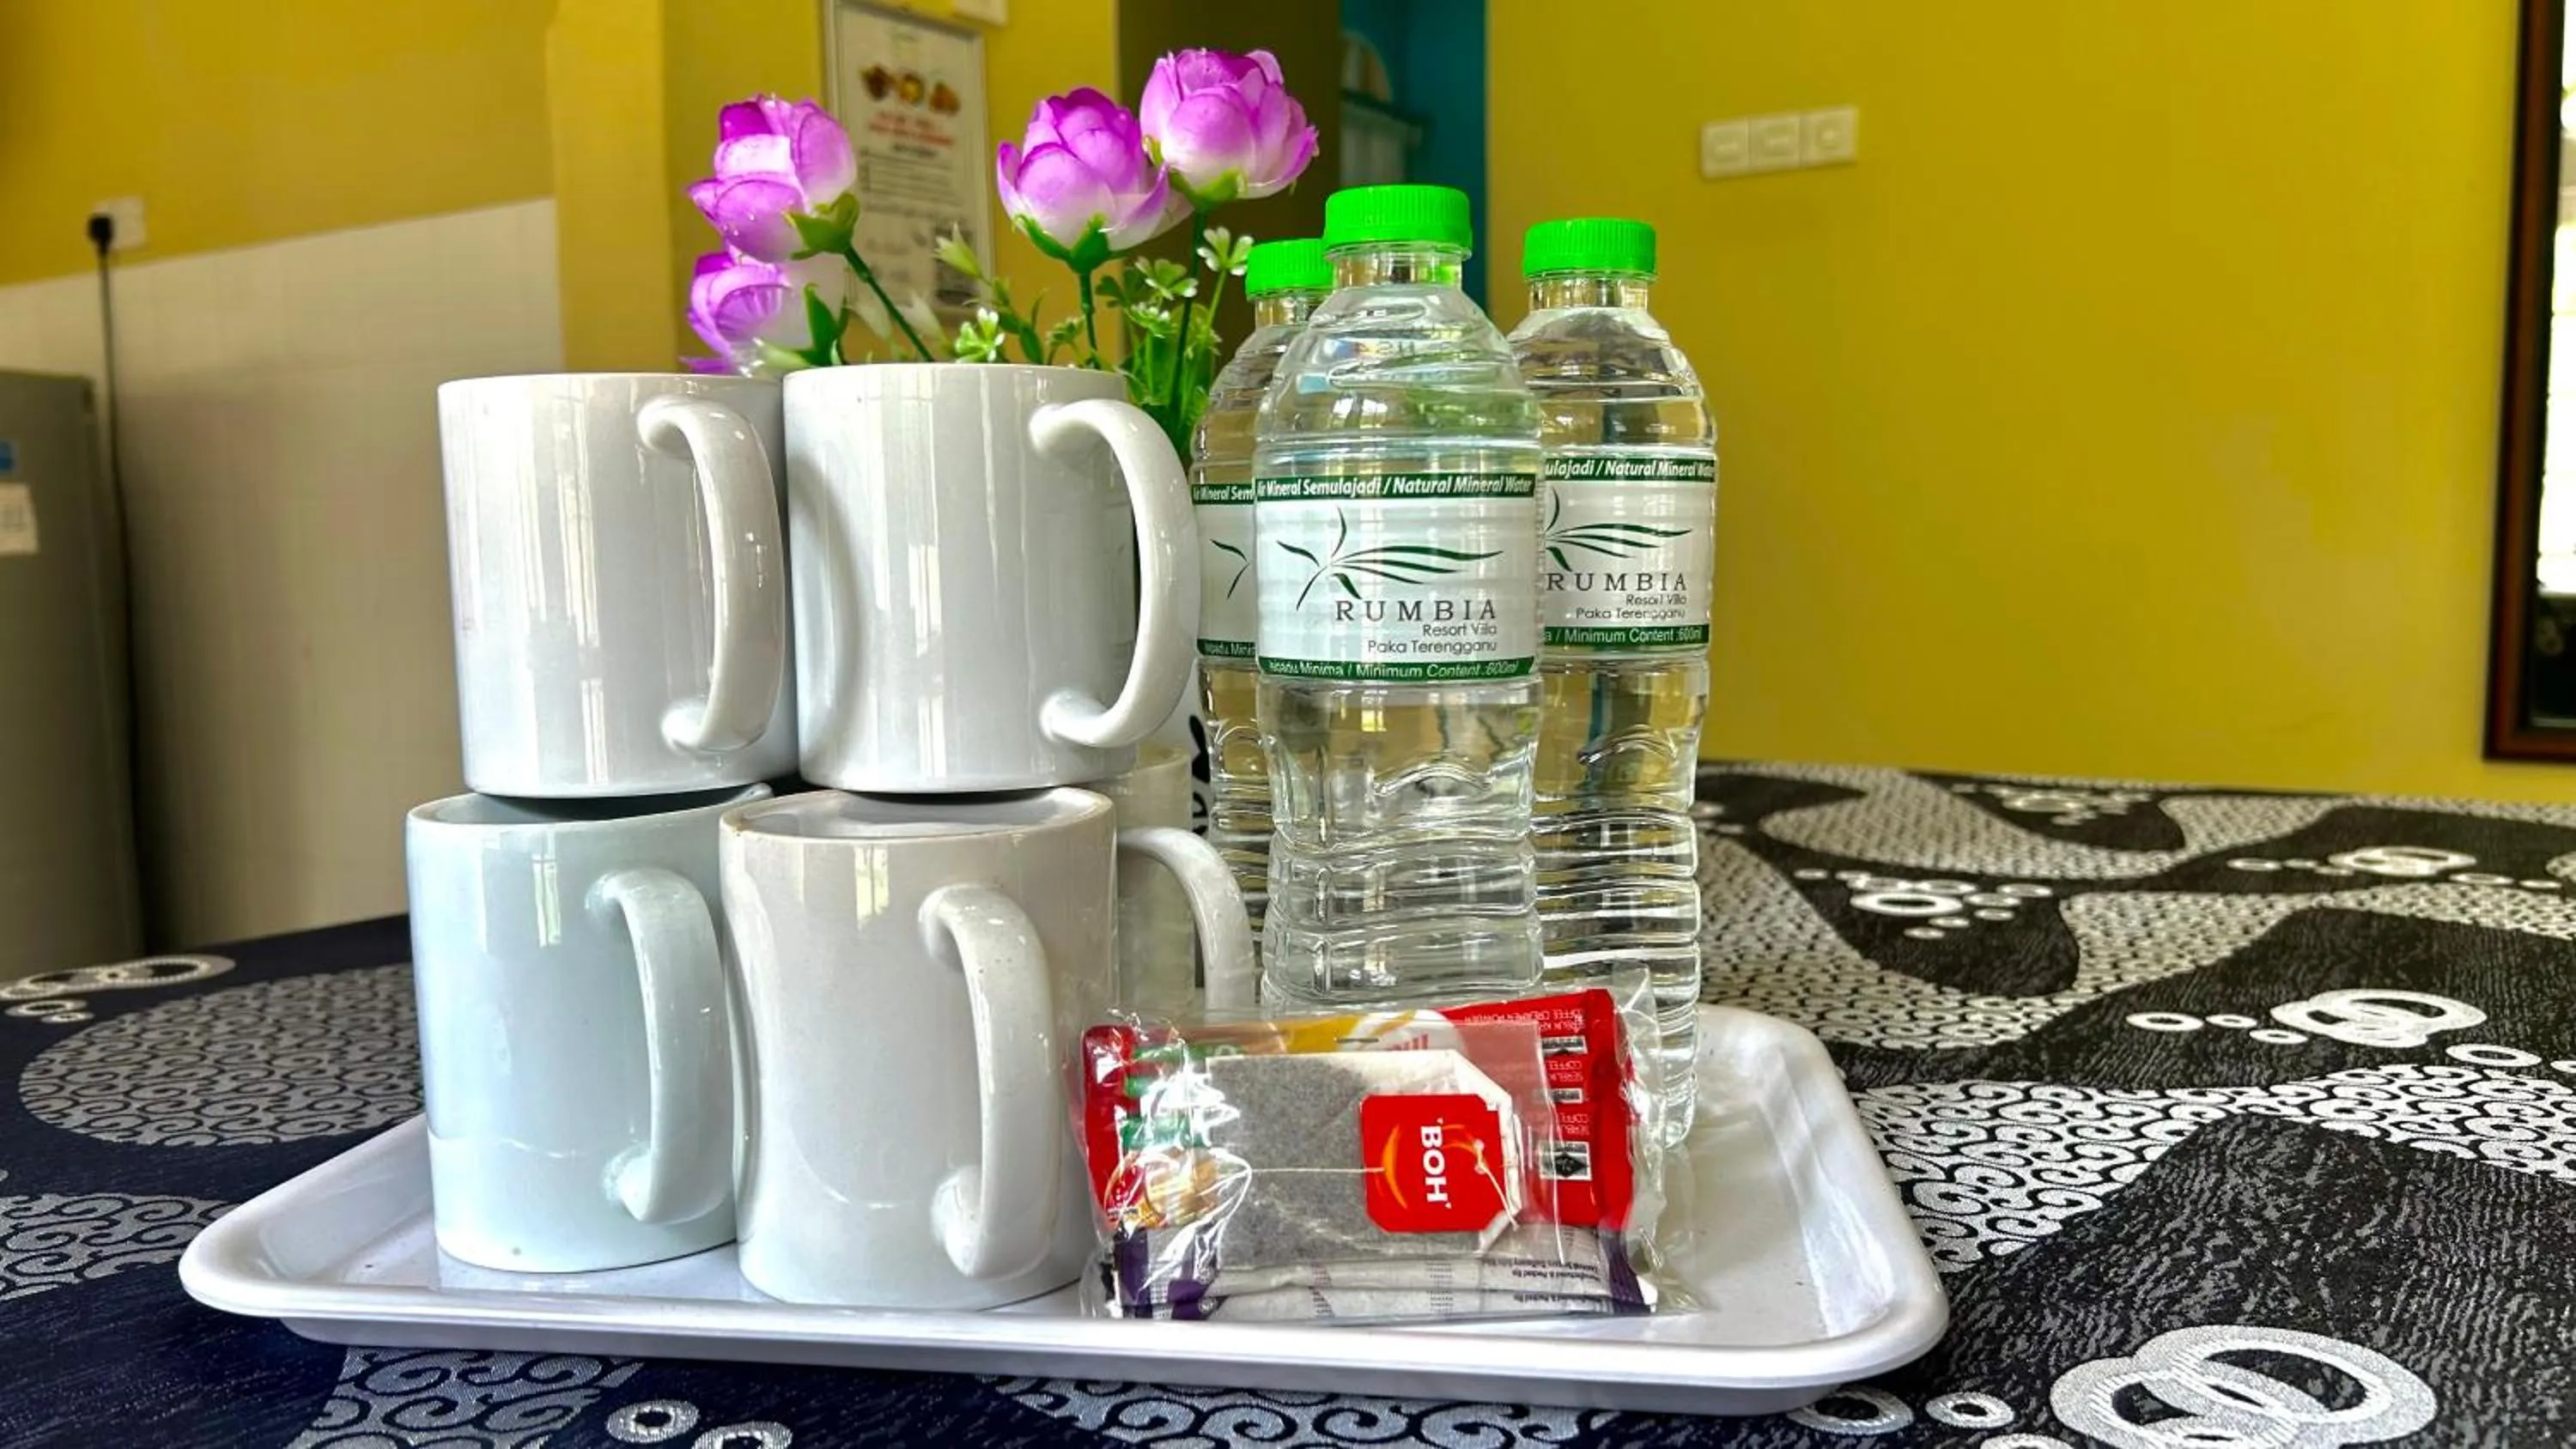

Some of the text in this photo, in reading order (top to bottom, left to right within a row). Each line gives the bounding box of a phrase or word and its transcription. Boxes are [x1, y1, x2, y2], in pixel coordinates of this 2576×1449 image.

[1546, 460, 1595, 480] ulajadi
[1606, 459, 1656, 476] Natural
[1657, 460, 1697, 476] Mineral
[1230, 485, 1255, 500] Sem
[1267, 478, 1302, 496] Mineral
[1303, 476, 1382, 498] Semulajadi
[1382, 476, 1392, 495] /
[1393, 475, 1451, 494] Natural
[1453, 475, 1504, 494] Mineral
[1504, 476, 1532, 494] Water
[1546, 573, 1688, 591] RUMBIA
[1625, 593, 1664, 606] Resort
[1335, 598, 1497, 622] RUMBIA
[1576, 607, 1613, 620] Paka
[1423, 622, 1498, 637] Resort Villa
[1564, 627, 1626, 643] Minimum
[1629, 627, 1674, 643] Content
[1368, 640, 1498, 656] Paka Terengganu
[1299, 661, 1345, 677] Minima
[1356, 663, 1423, 678] Minimum
[1426, 663, 1479, 678] Content
[1420, 1125, 1449, 1203] BOH
